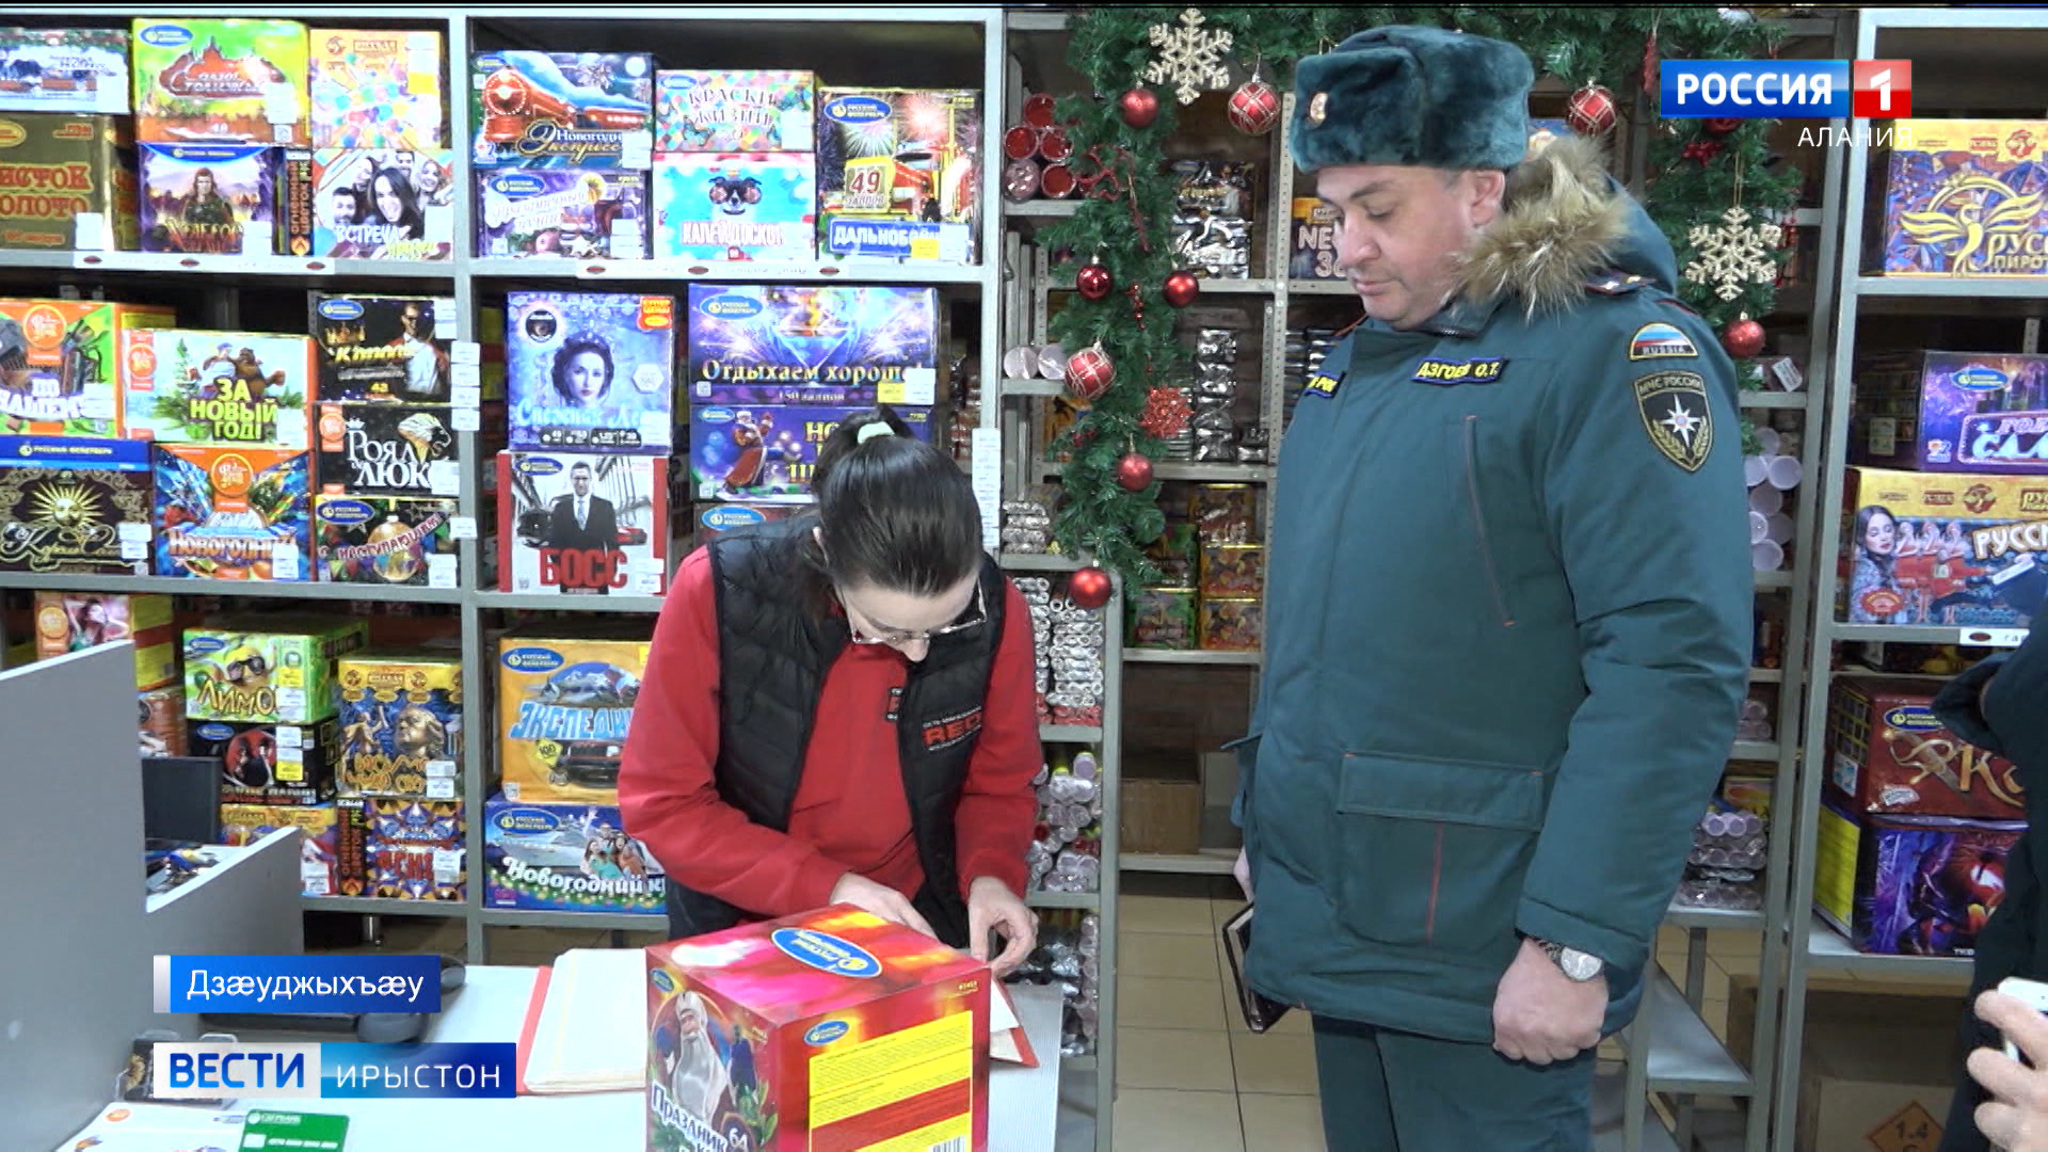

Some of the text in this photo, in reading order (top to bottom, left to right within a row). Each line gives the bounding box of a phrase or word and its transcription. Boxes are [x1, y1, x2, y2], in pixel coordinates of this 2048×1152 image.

[850, 169, 881, 194] 49
[1298, 225, 1333, 250] NE
[701, 359, 820, 383] Отдыхаем
[215, 378, 252, 401] ЗА
[189, 398, 278, 423] НОВЫЙ
[353, 461, 431, 488] ЛЮК
[539, 548, 628, 588] БОСС
[197, 678, 276, 715] ЛИМО
[508, 700, 634, 740] ЭКСПЕДИ
[502, 856, 643, 894] Новогодний
